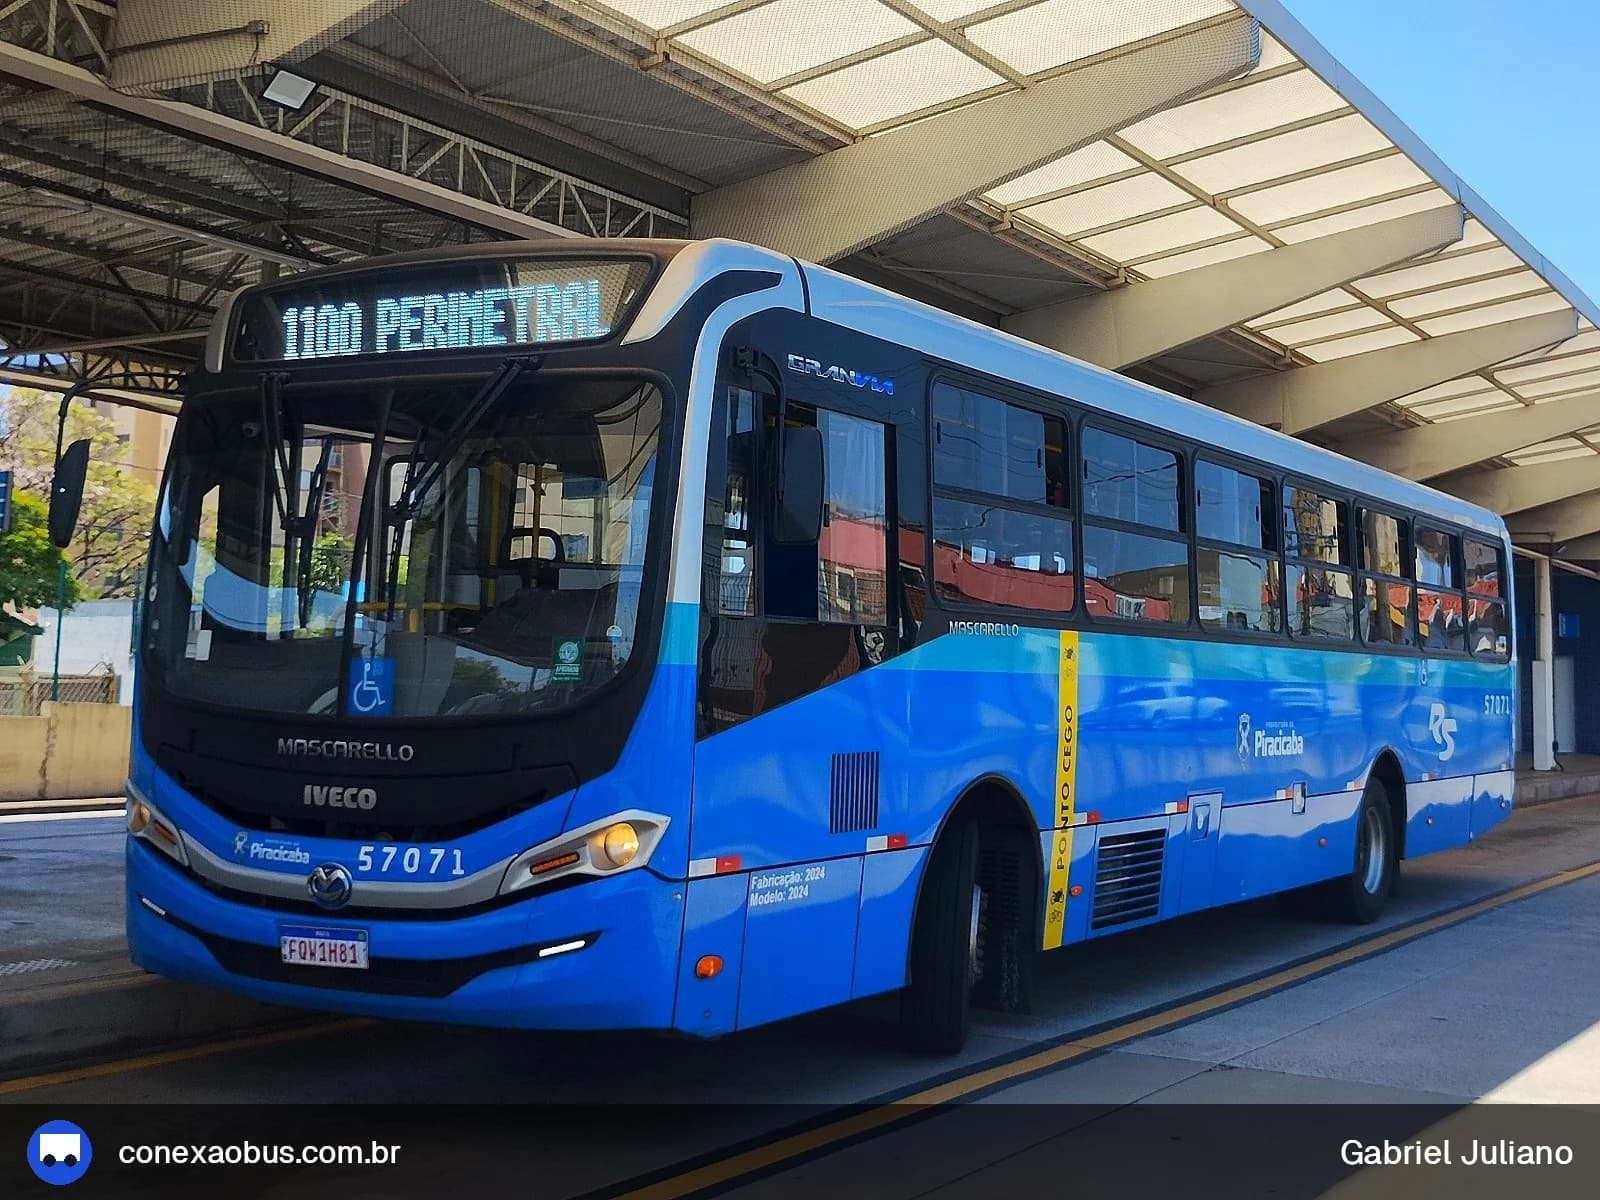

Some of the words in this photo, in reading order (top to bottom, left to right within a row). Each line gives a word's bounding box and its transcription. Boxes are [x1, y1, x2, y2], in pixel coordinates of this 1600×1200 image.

[282, 302, 363, 360] 1100
[376, 279, 611, 353] PERIMETRAL
[948, 620, 1019, 637] MASCARELLO
[1484, 694, 1510, 715] 57071
[277, 738, 414, 761] MASCARELLO
[1062, 705, 1073, 773] CEGO
[1254, 729, 1304, 758] Piracicaba
[303, 784, 377, 810] IVECO
[1056, 782, 1070, 870] PONTO
[250, 842, 310, 865] Piracicaba
[358, 845, 465, 875] 57071
[751, 870, 804, 890] Fabricação:
[805, 866, 825, 881] 2024
[750, 889, 786, 907] Modelo:
[787, 884, 809, 900] 2024
[288, 939, 358, 964] FQW1H81
